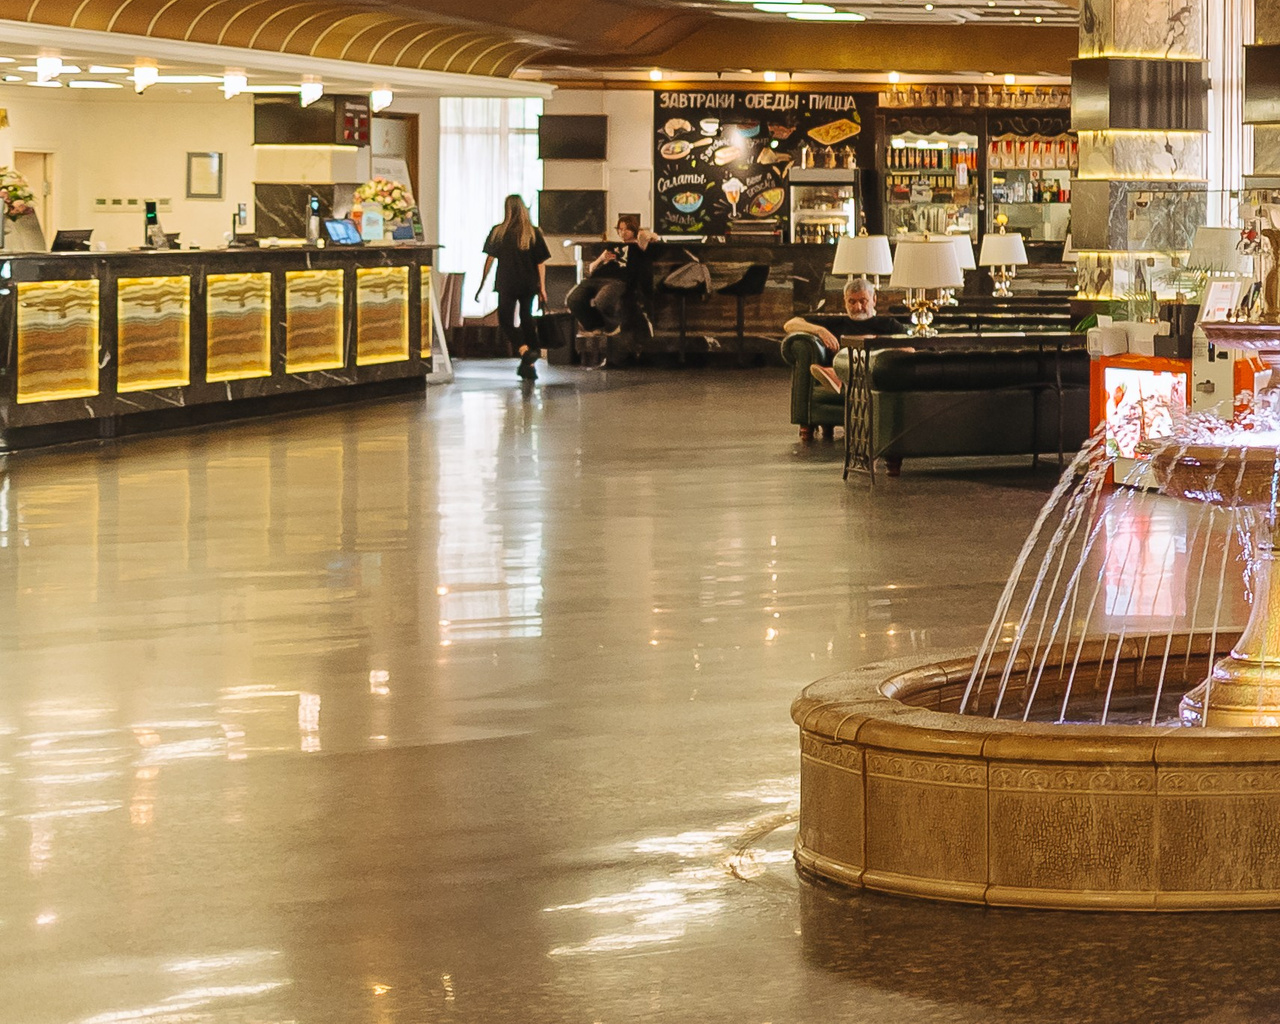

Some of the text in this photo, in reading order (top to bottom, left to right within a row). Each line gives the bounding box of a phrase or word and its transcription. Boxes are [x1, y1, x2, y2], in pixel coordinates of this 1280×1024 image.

[660, 93, 856, 112] ЗАВТРАКИ ОБЕДЫ ПИЦЦА
